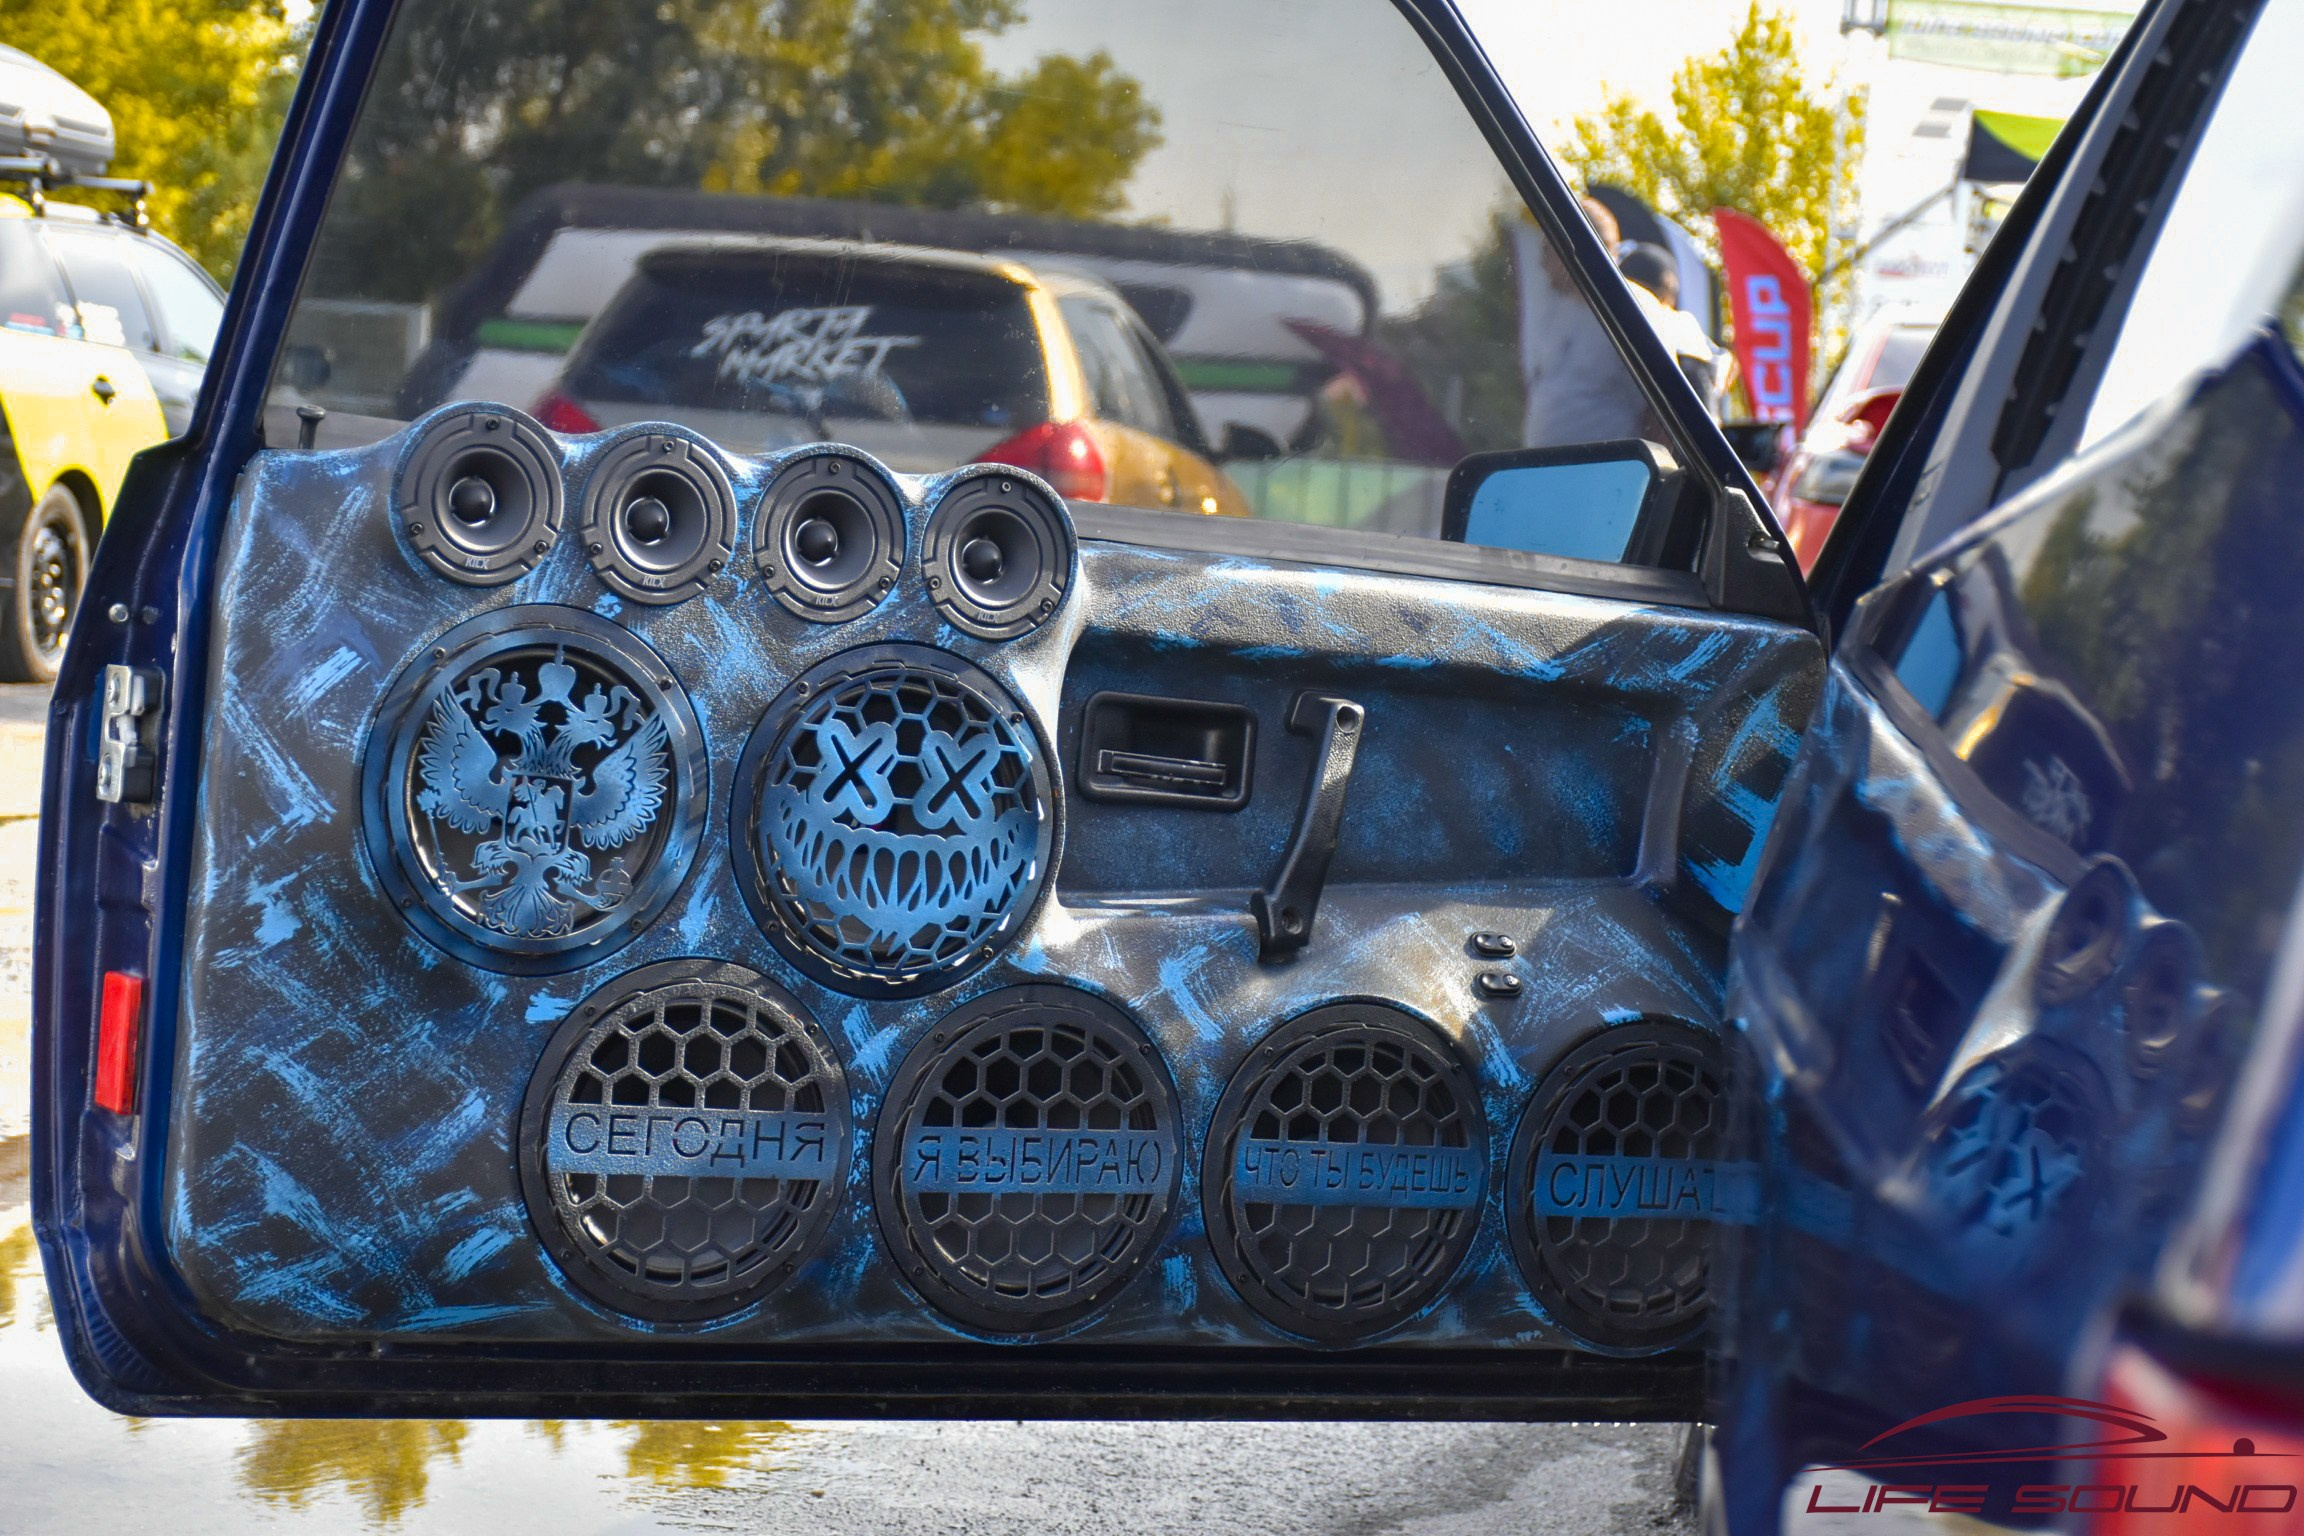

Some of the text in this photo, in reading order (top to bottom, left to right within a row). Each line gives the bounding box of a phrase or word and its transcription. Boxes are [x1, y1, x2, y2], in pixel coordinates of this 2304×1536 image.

[720, 335, 922, 382] MARKET
[1746, 274, 1795, 420] CUP
[565, 1112, 825, 1168] СЕГОДНЯ
[913, 1135, 1162, 1185] Я ВЫБИРАЮ
[1244, 1146, 1470, 1200] ЧТО ТЫ БУДЕШЬ
